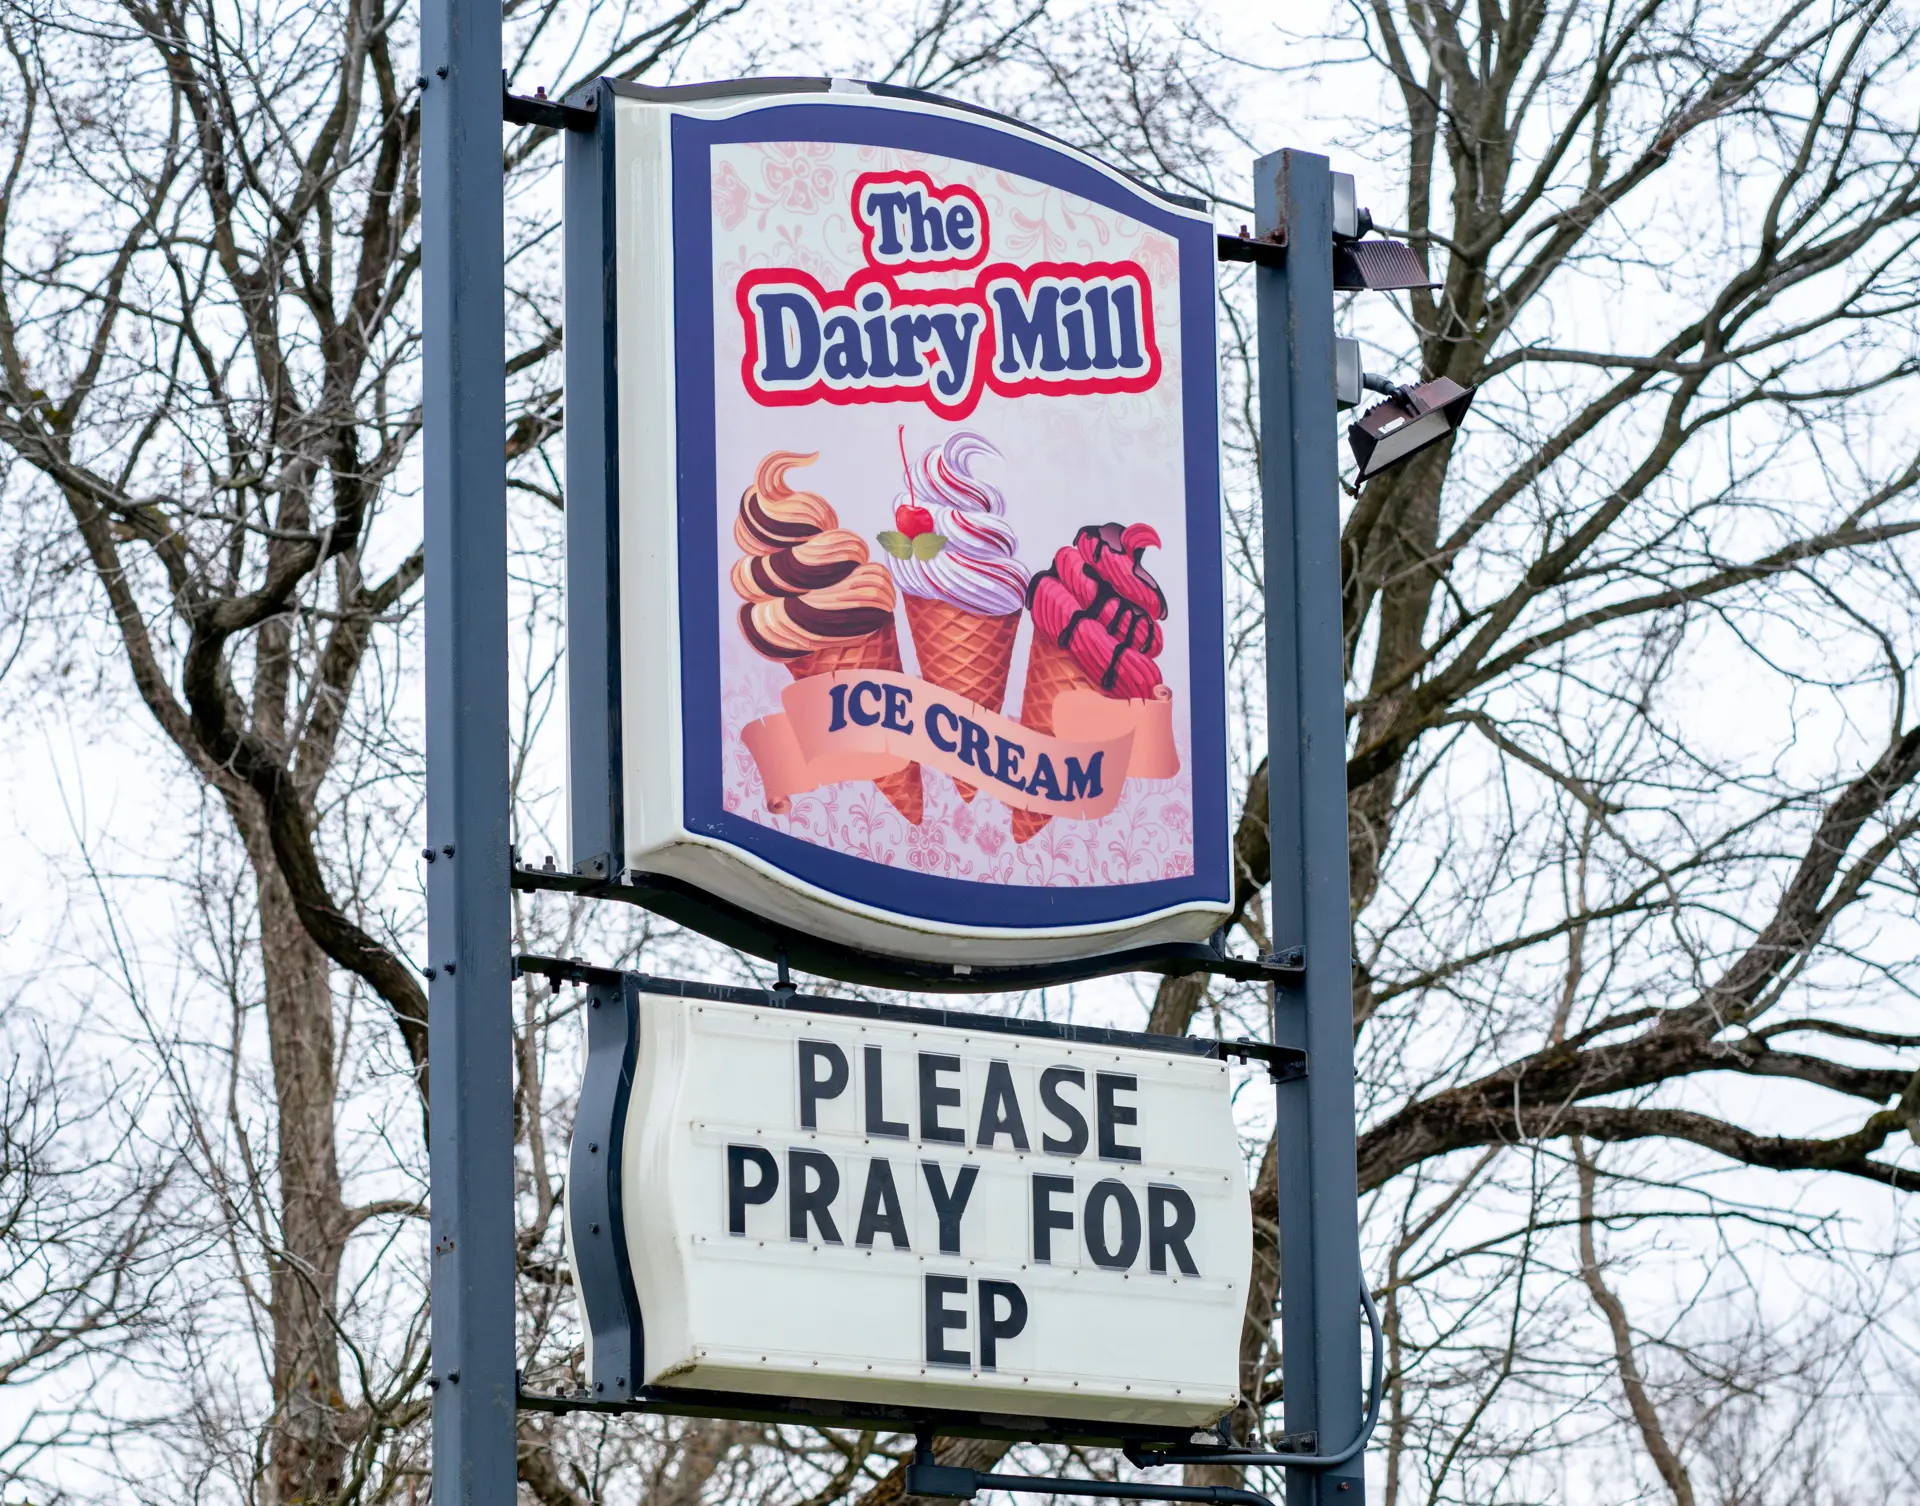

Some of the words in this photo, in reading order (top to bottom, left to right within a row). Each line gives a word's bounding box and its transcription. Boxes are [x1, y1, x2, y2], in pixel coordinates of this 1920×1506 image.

[866, 191, 975, 255] The
[756, 291, 979, 396] Dairy
[993, 284, 1144, 374] Mill
[828, 681, 914, 735] ICE
[924, 703, 1105, 802] CREAM
[798, 1038, 1142, 1163] PLEASE
[727, 1142, 981, 1256] PRAY
[1031, 1172, 1201, 1278] FOR
[925, 1273, 1029, 1373] EP
